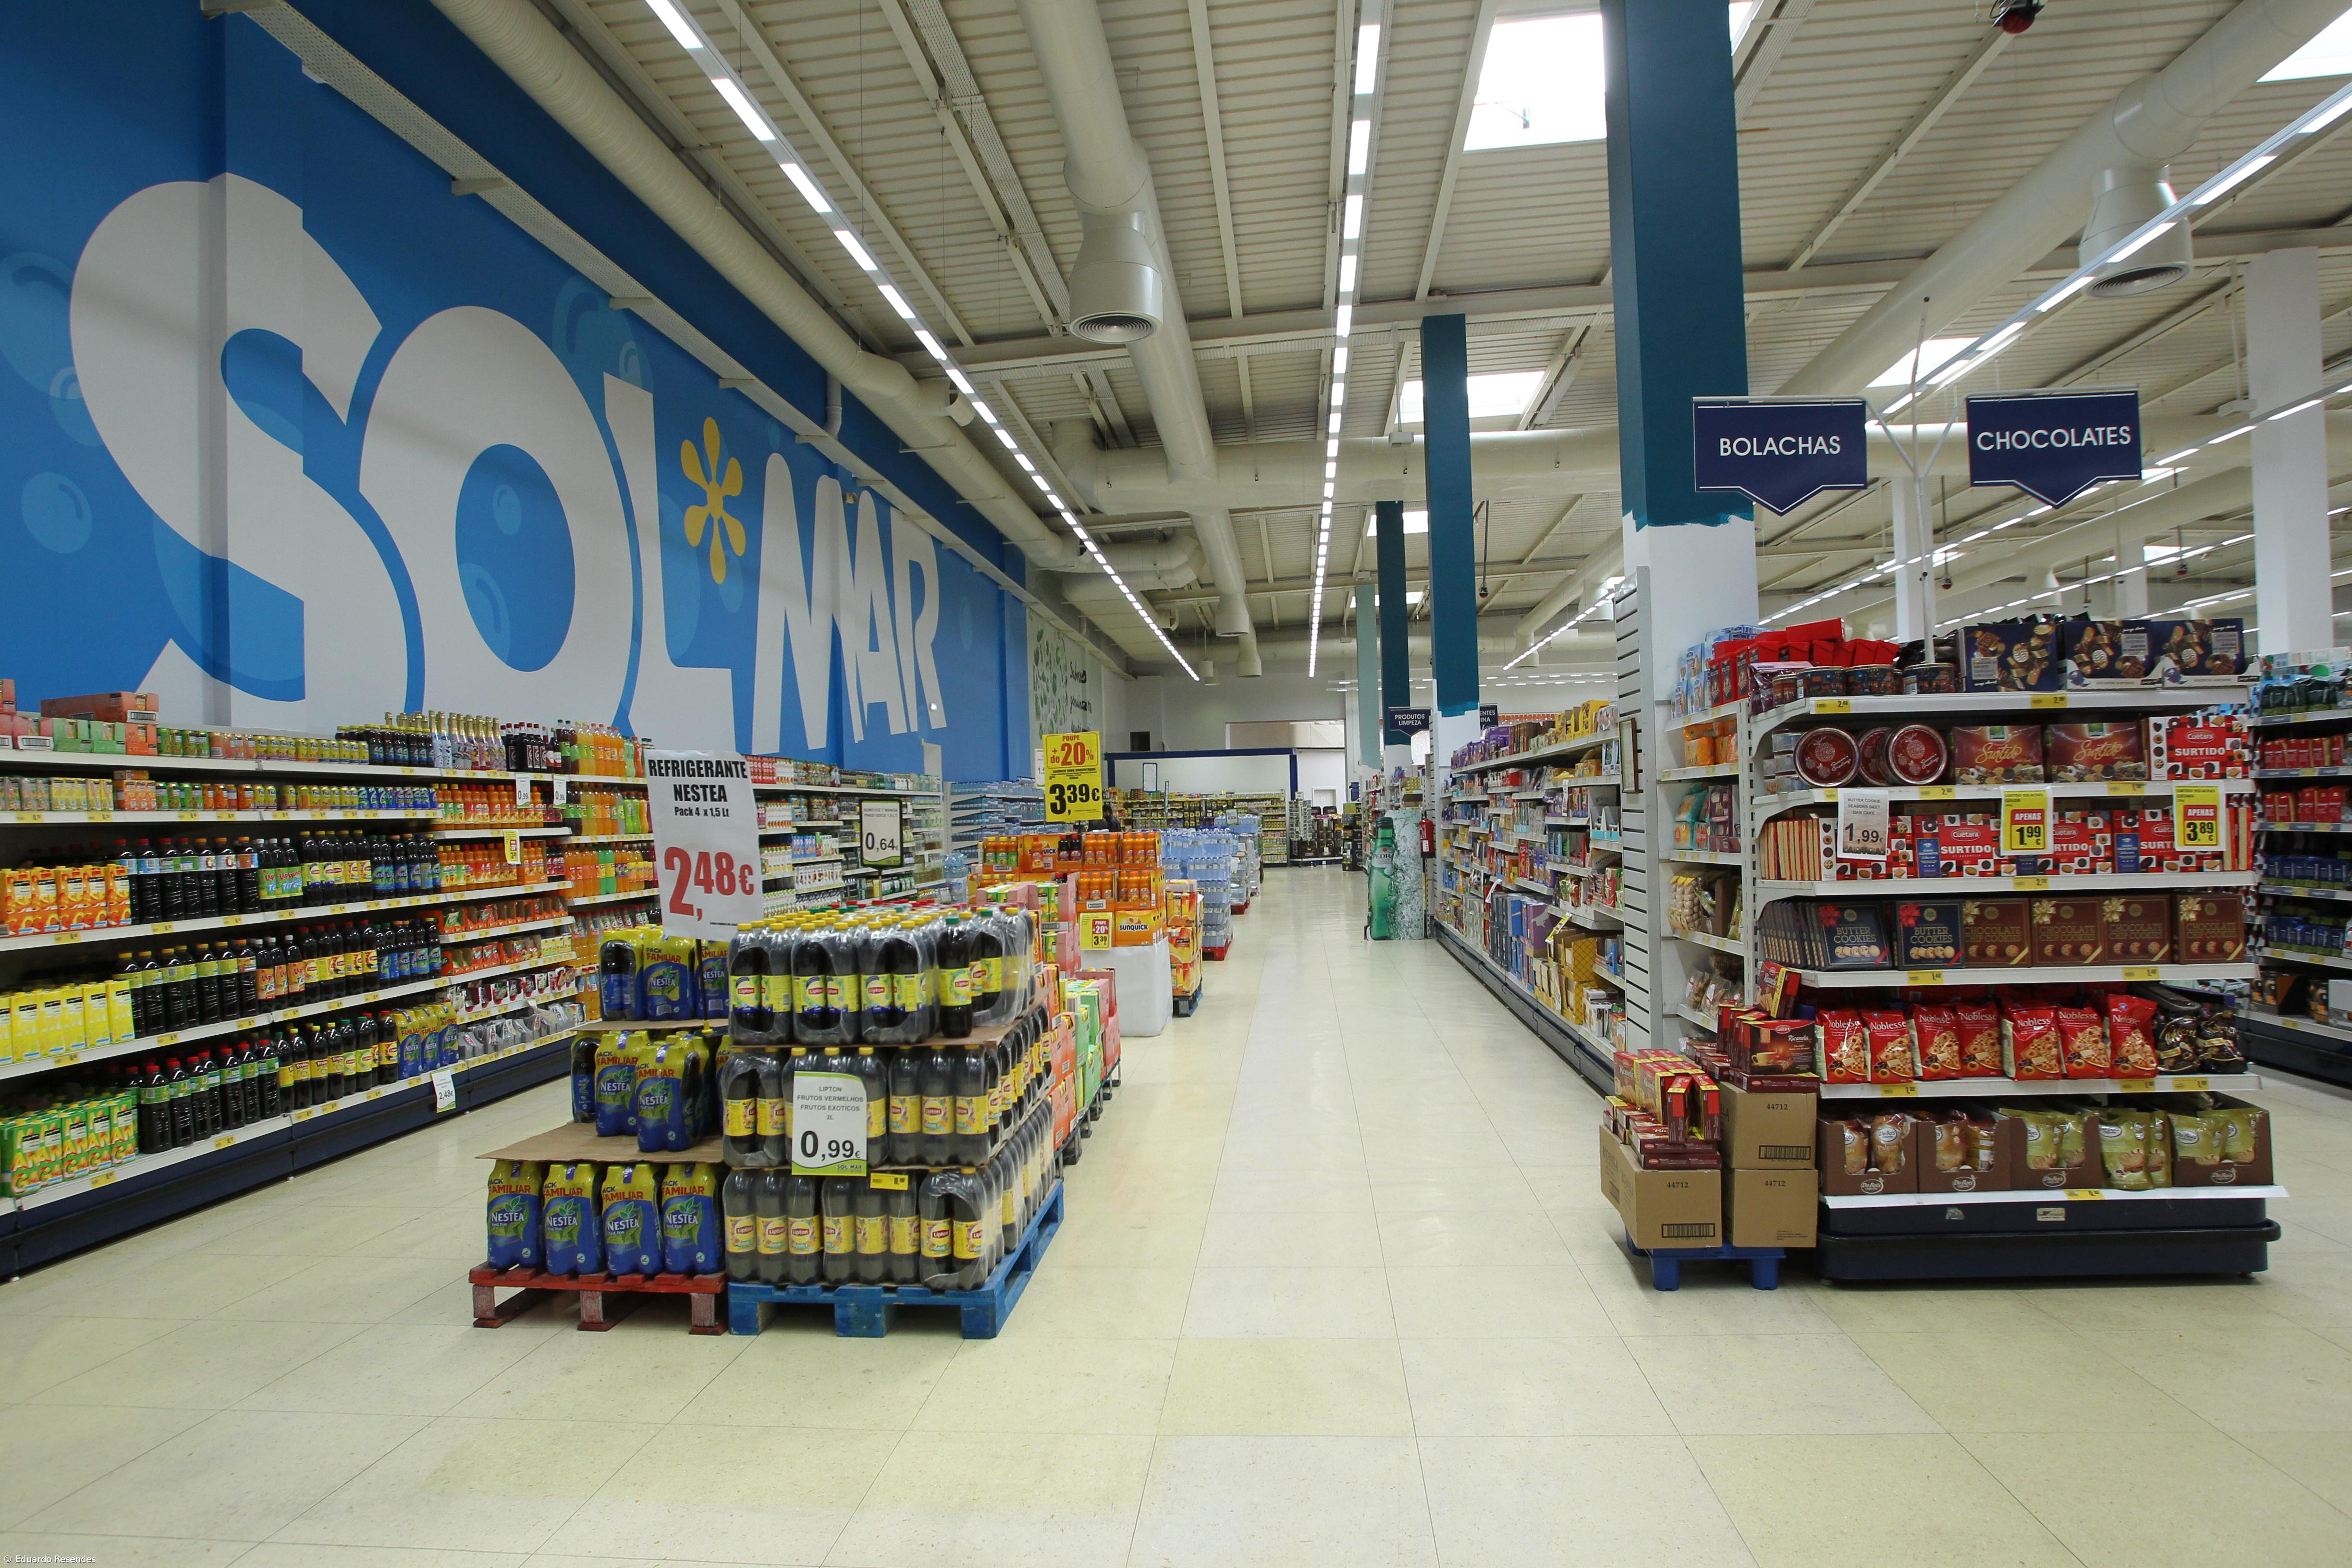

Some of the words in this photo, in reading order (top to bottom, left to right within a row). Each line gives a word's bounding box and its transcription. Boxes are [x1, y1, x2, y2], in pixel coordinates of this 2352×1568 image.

[1977, 426, 2132, 452] CHOCOLATES
[1720, 436, 1841, 457] BOLACHAS
[71, 174, 735, 753] SOL
[752, 452, 947, 755] MAR
[1051, 755, 1060, 763] de
[1060, 742, 1094, 766] 20%
[2175, 747, 2226, 756] SURTIDO
[648, 759, 748, 779] REFRIGERANTE
[673, 784, 728, 802] NESTEA
[674, 807, 693, 817] Pack
[695, 807, 700, 817] 4
[710, 807, 721, 818] 1,5
[722, 808, 729, 817] Lt
[1940, 845, 1992, 854] SURTIDO
[2054, 843, 2088, 852] RTIDO
[2140, 841, 2172, 849] SURT
[1836, 926, 1871, 935] BUTTER
[1913, 926, 1949, 936] BUTTER
[1964, 927, 2021, 935] CHOCOLATE
[2040, 925, 2095, 934] CHOCOLATE
[2109, 923, 2162, 932] CHOCOLATE
[2186, 922, 2236, 931] CHOCOLATE
[1833, 934, 1876, 944] COOKIES
[1910, 935, 1953, 944] COOKIES
[646, 953, 681, 963] FAMILIAR
[701, 950, 728, 958] AMILIAR
[703, 971, 725, 979] NESTEA
[650, 978, 675, 986] NESTEA
[1919, 1014, 1951, 1024] Noblesse
[1960, 1012, 1997, 1021] Noblesse
[2058, 1010, 2097, 1020] Noblesse
[1870, 1020, 1907, 1030] Noblesse
[597, 1057, 638, 1066] FAMILIAR
[600, 1082, 631, 1092] NESTEA
[640, 1095, 669, 1105] NESTEA
[800, 1130, 860, 1162] 0,99€
[489, 1185, 531, 1194] FAMILIAR
[543, 1188, 584, 1197] FAMILIAR
[662, 1186, 705, 1196] FAMILIAR
[491, 1212, 525, 1222] NESTEA
[546, 1216, 578, 1226] NESTEA
[665, 1213, 698, 1225] NESTEA
[607, 1219, 640, 1231] NESTEA
